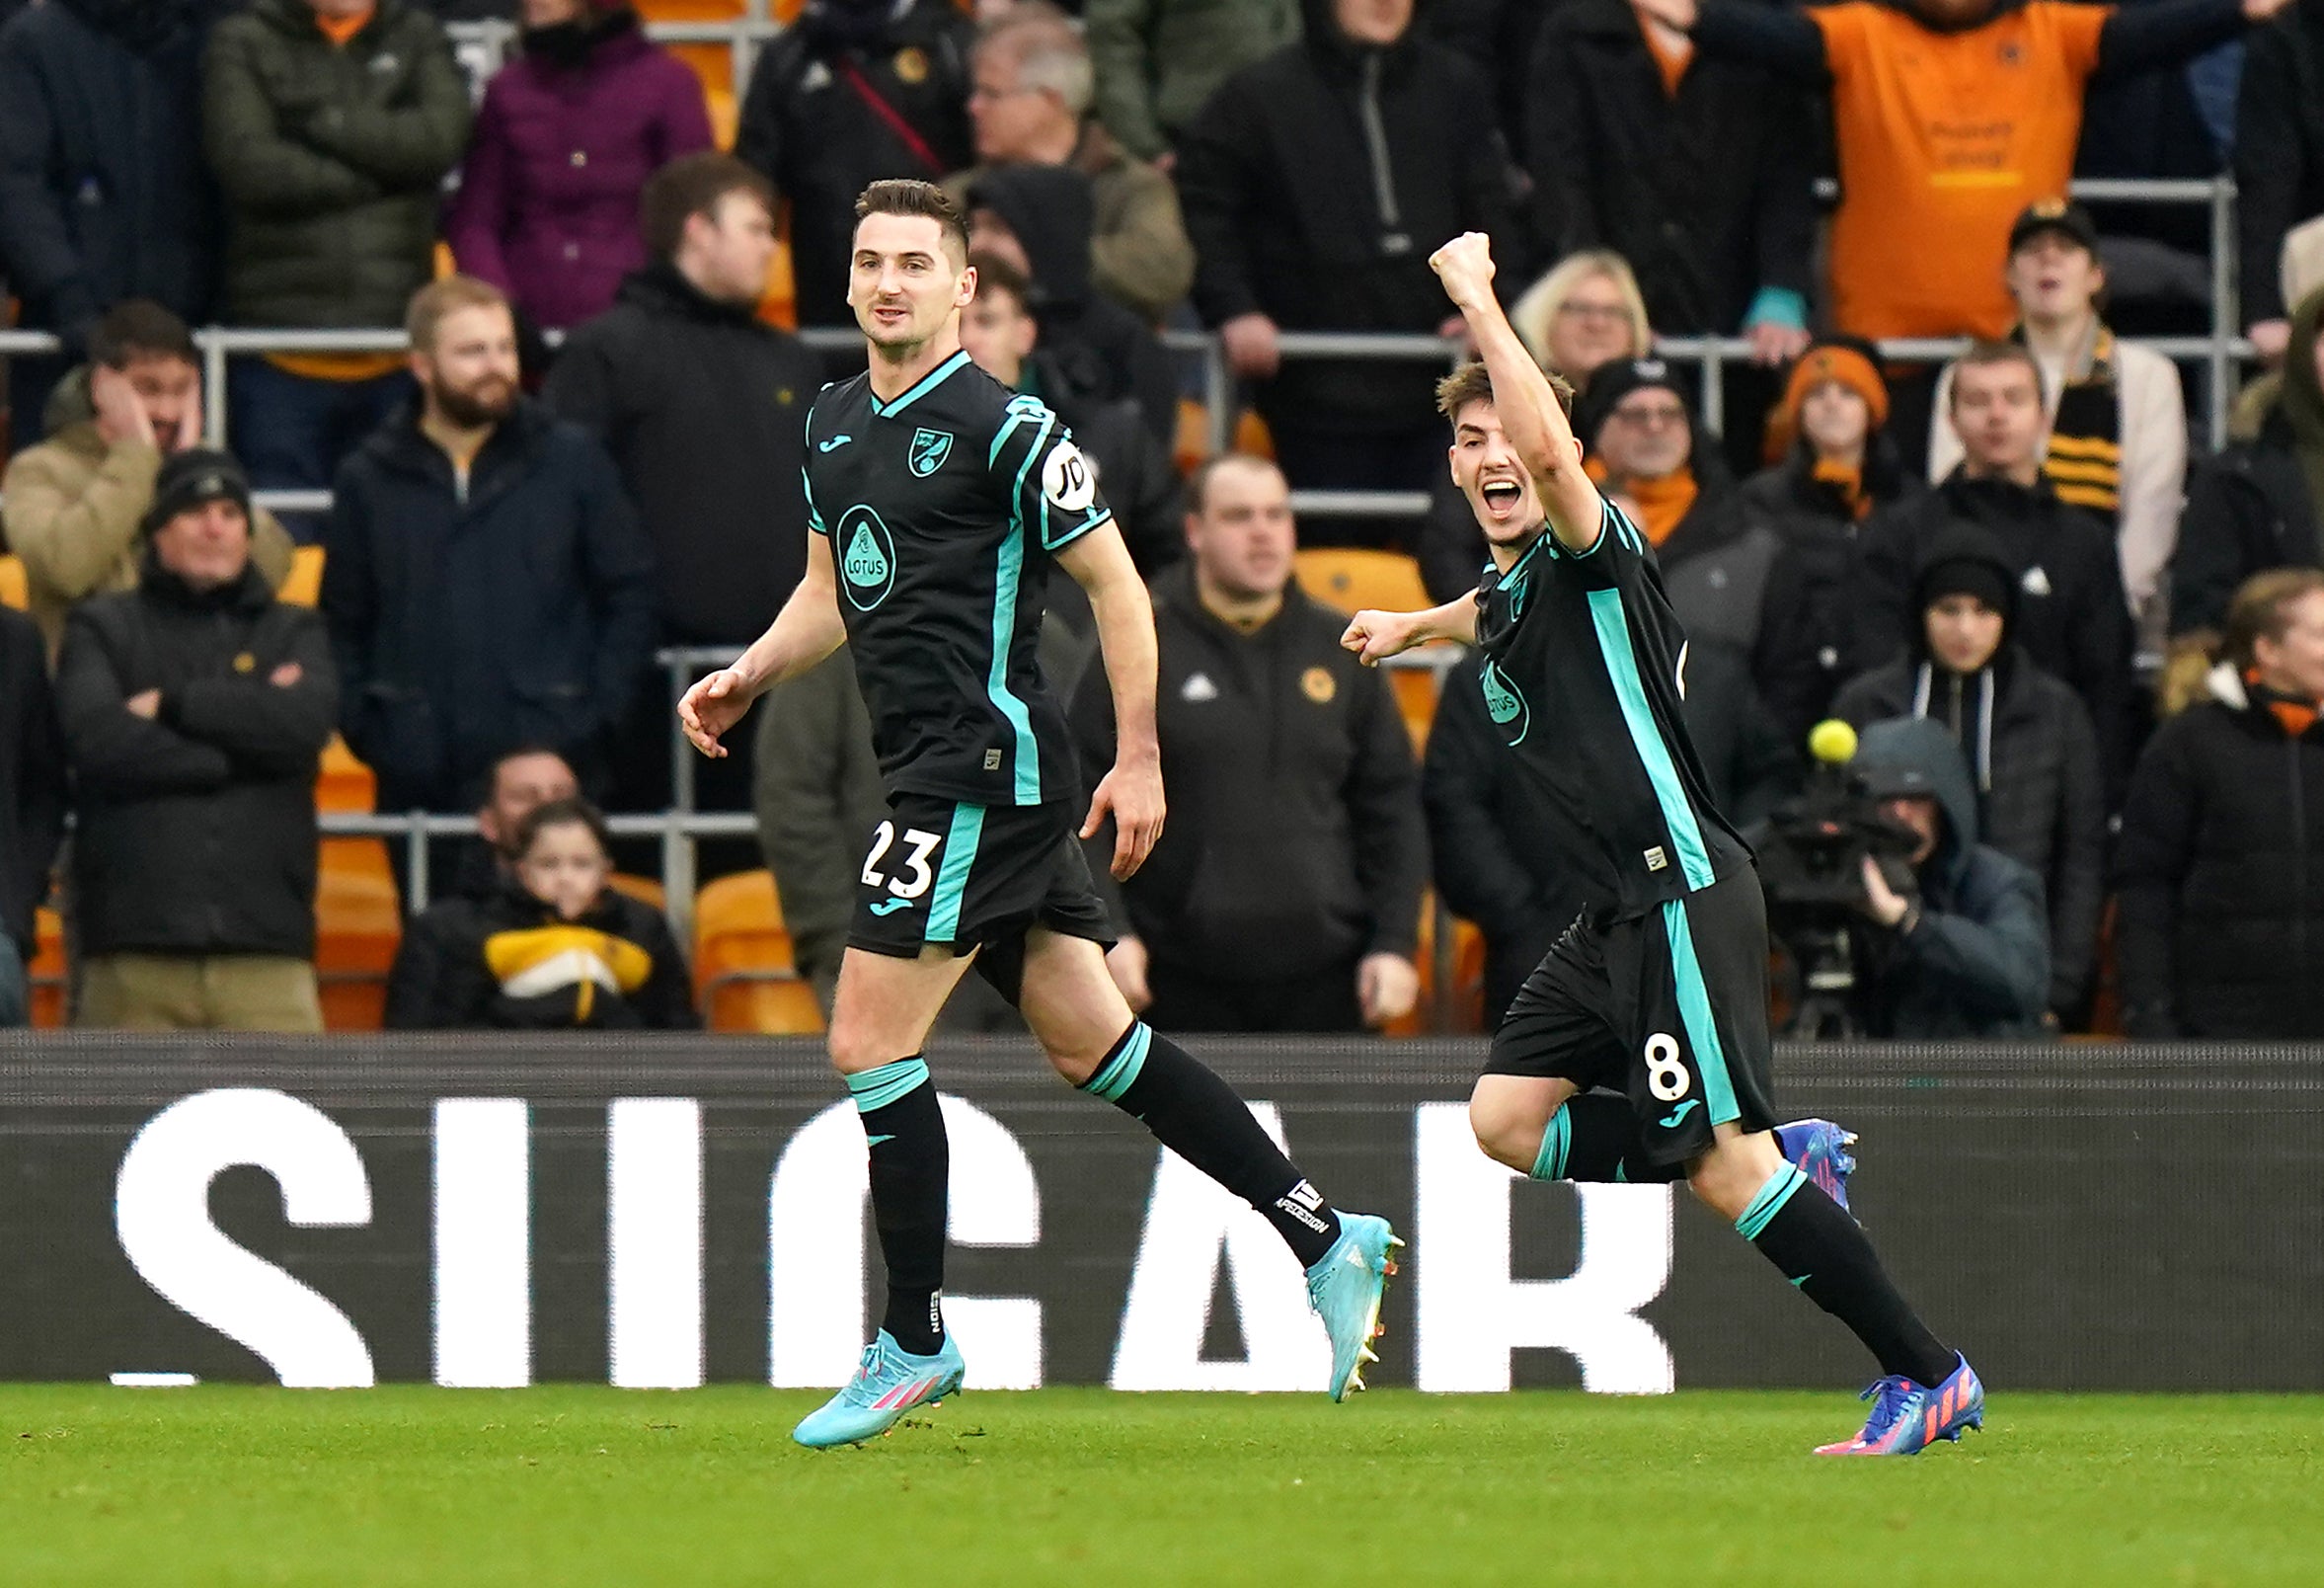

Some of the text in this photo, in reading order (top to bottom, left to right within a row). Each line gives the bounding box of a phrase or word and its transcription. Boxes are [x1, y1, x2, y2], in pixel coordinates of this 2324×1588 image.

[1055, 455, 1085, 501] JD
[847, 559, 885, 575] LOTUS
[1488, 694, 1515, 713] OTUS
[861, 820, 943, 899] 23
[1644, 1032, 1691, 1101] 8
[109, 1087, 1675, 1394] SUGAR
